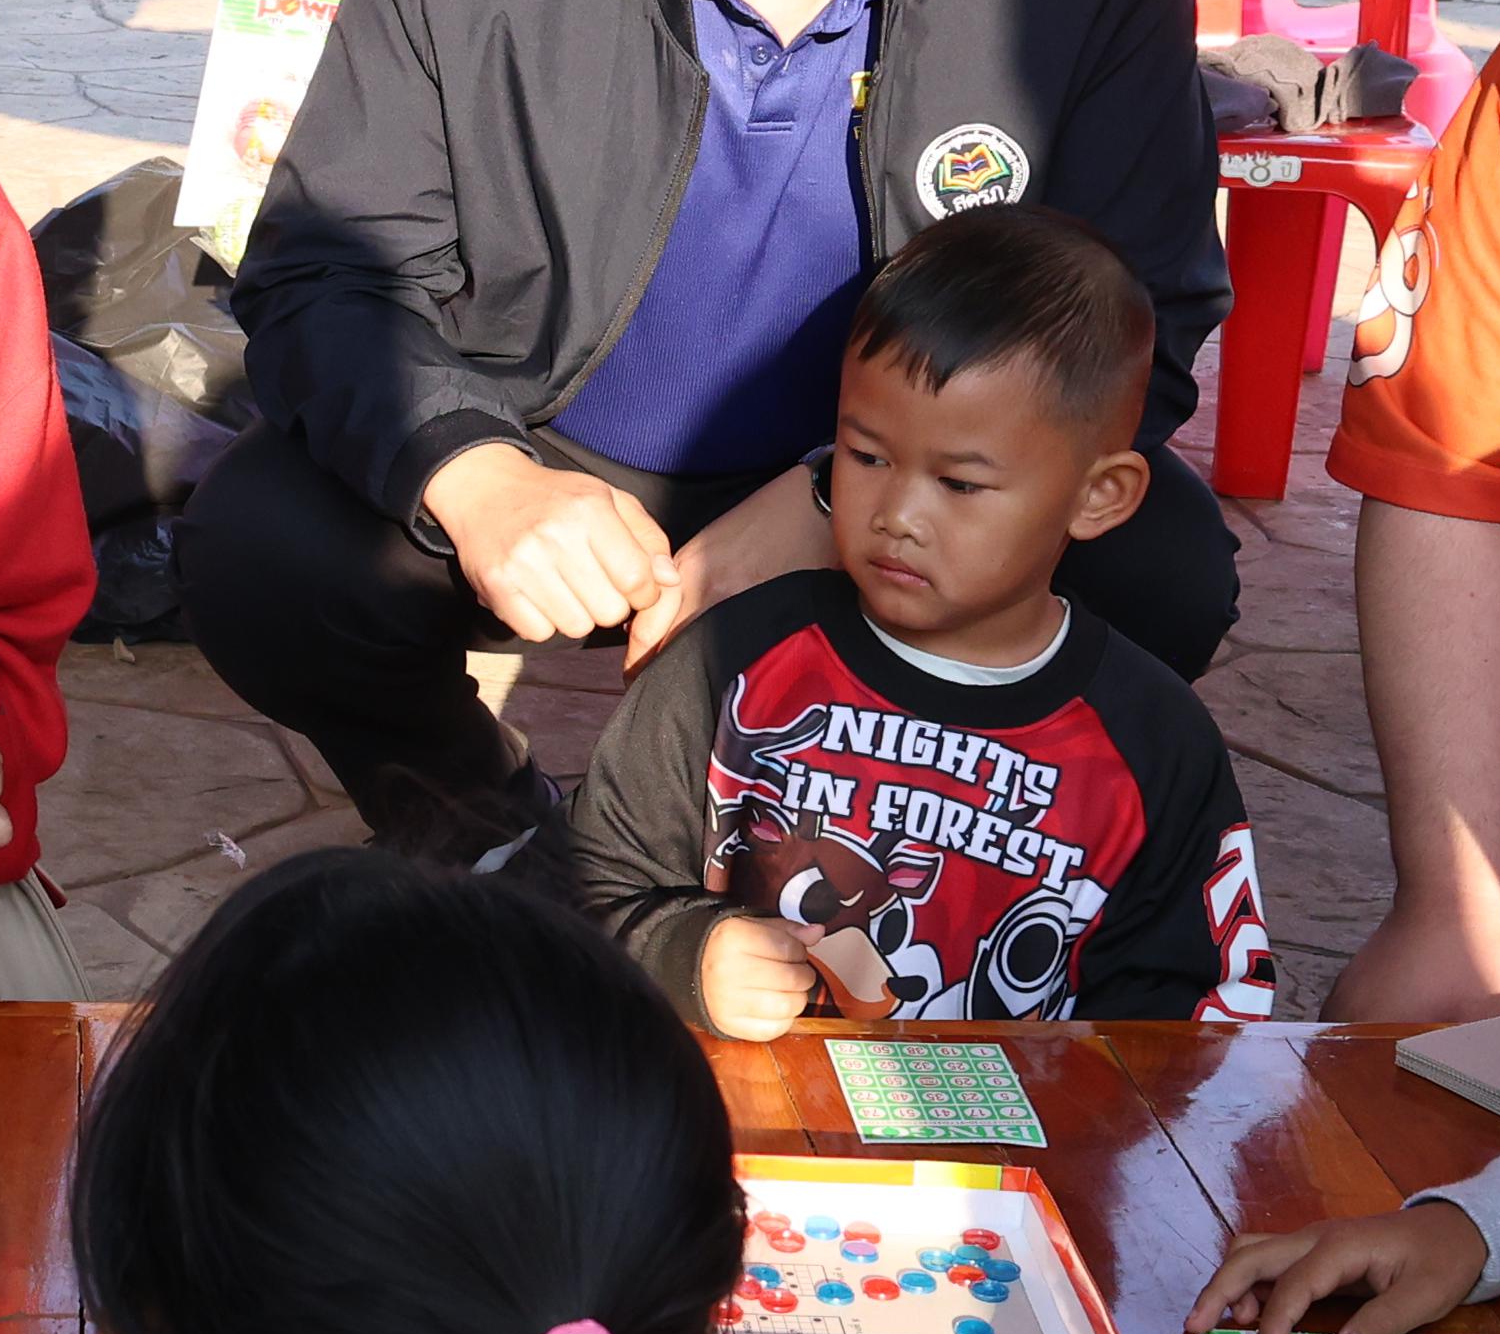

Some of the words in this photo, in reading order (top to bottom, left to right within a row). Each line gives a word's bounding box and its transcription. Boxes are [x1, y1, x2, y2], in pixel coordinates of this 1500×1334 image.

[823, 704, 1060, 808] NIGHTS
[870, 783, 1086, 893] FOREST
[874, 1125, 1033, 1140] BINGO
